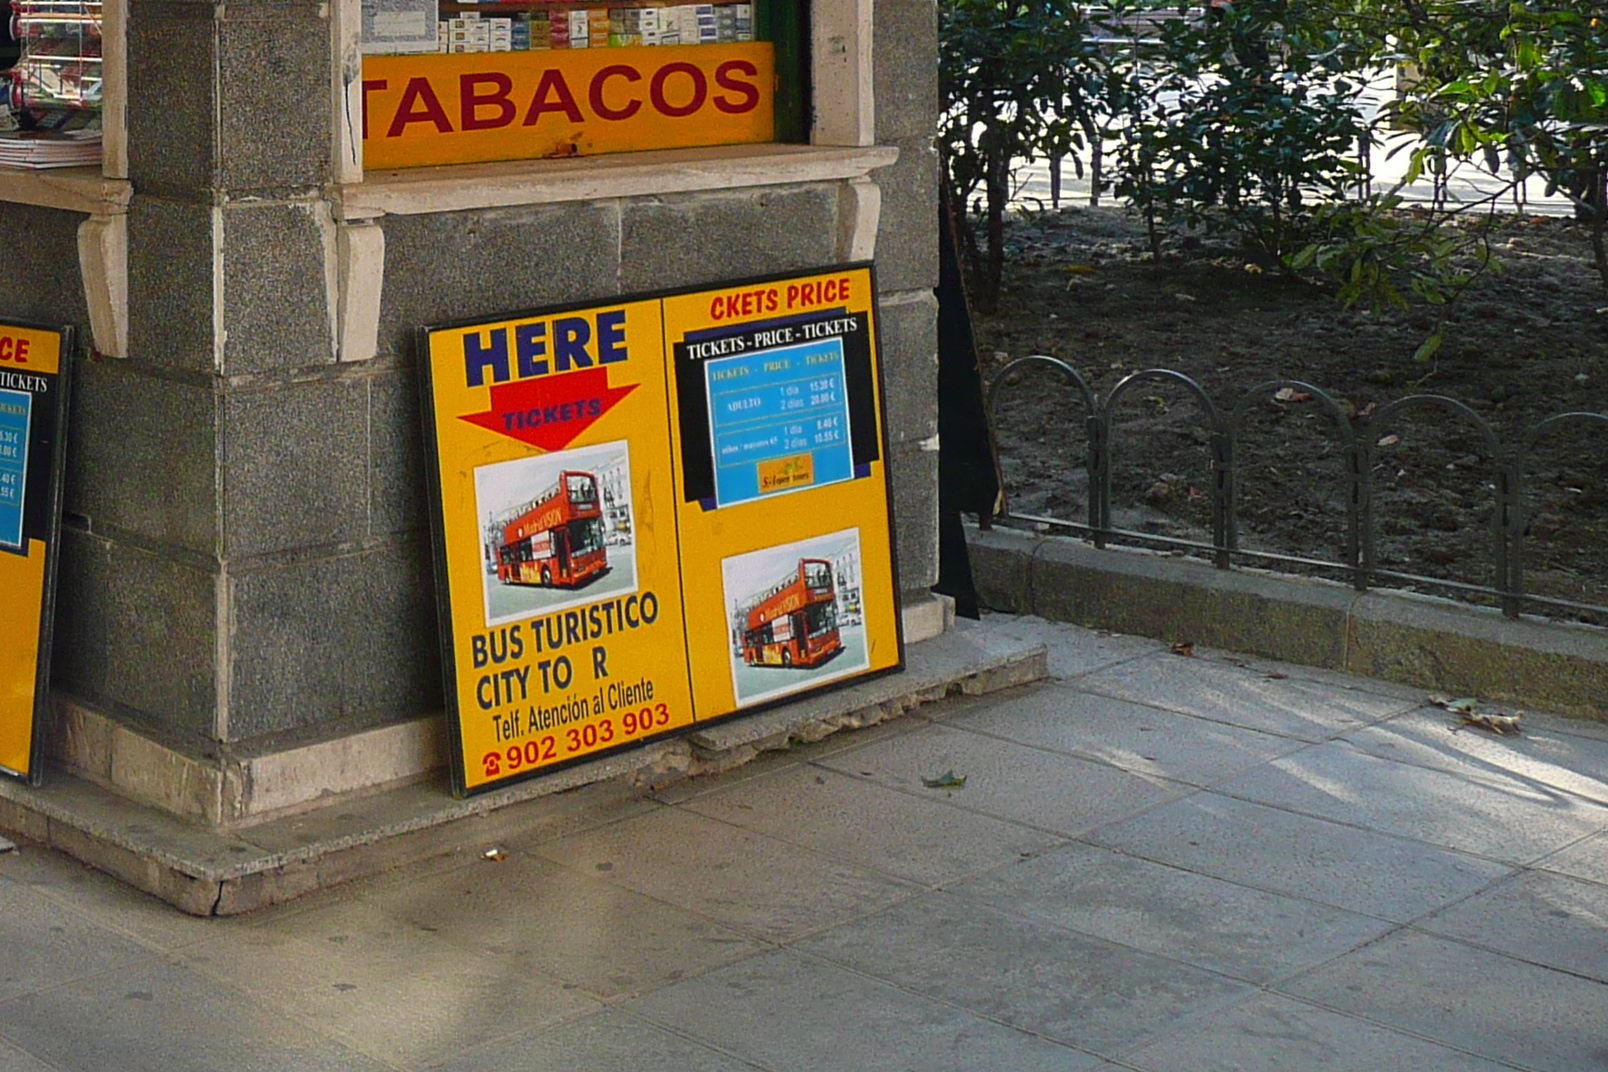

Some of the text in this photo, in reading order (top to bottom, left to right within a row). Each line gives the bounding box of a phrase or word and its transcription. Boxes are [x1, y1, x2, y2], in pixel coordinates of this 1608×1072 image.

[361, 60, 760, 139] TABACOS
[710, 277, 850, 320] CKETS PRICE
[463, 309, 628, 388] HERE
[687, 317, 858, 360] TICKETS PRICE TICKETS
[0, 371, 48, 393] TICKETS
[712, 366, 750, 381] TICKETS
[763, 359, 791, 373] PRICE
[502, 398, 602, 431] TICKETS
[727, 397, 762, 412] ADULTO
[471, 591, 659, 669] BUS TURISTICO
[476, 665, 531, 710] CITY
[493, 676, 654, 743] Telf. Atención al Cliente
[506, 703, 670, 770] 902 303 903
